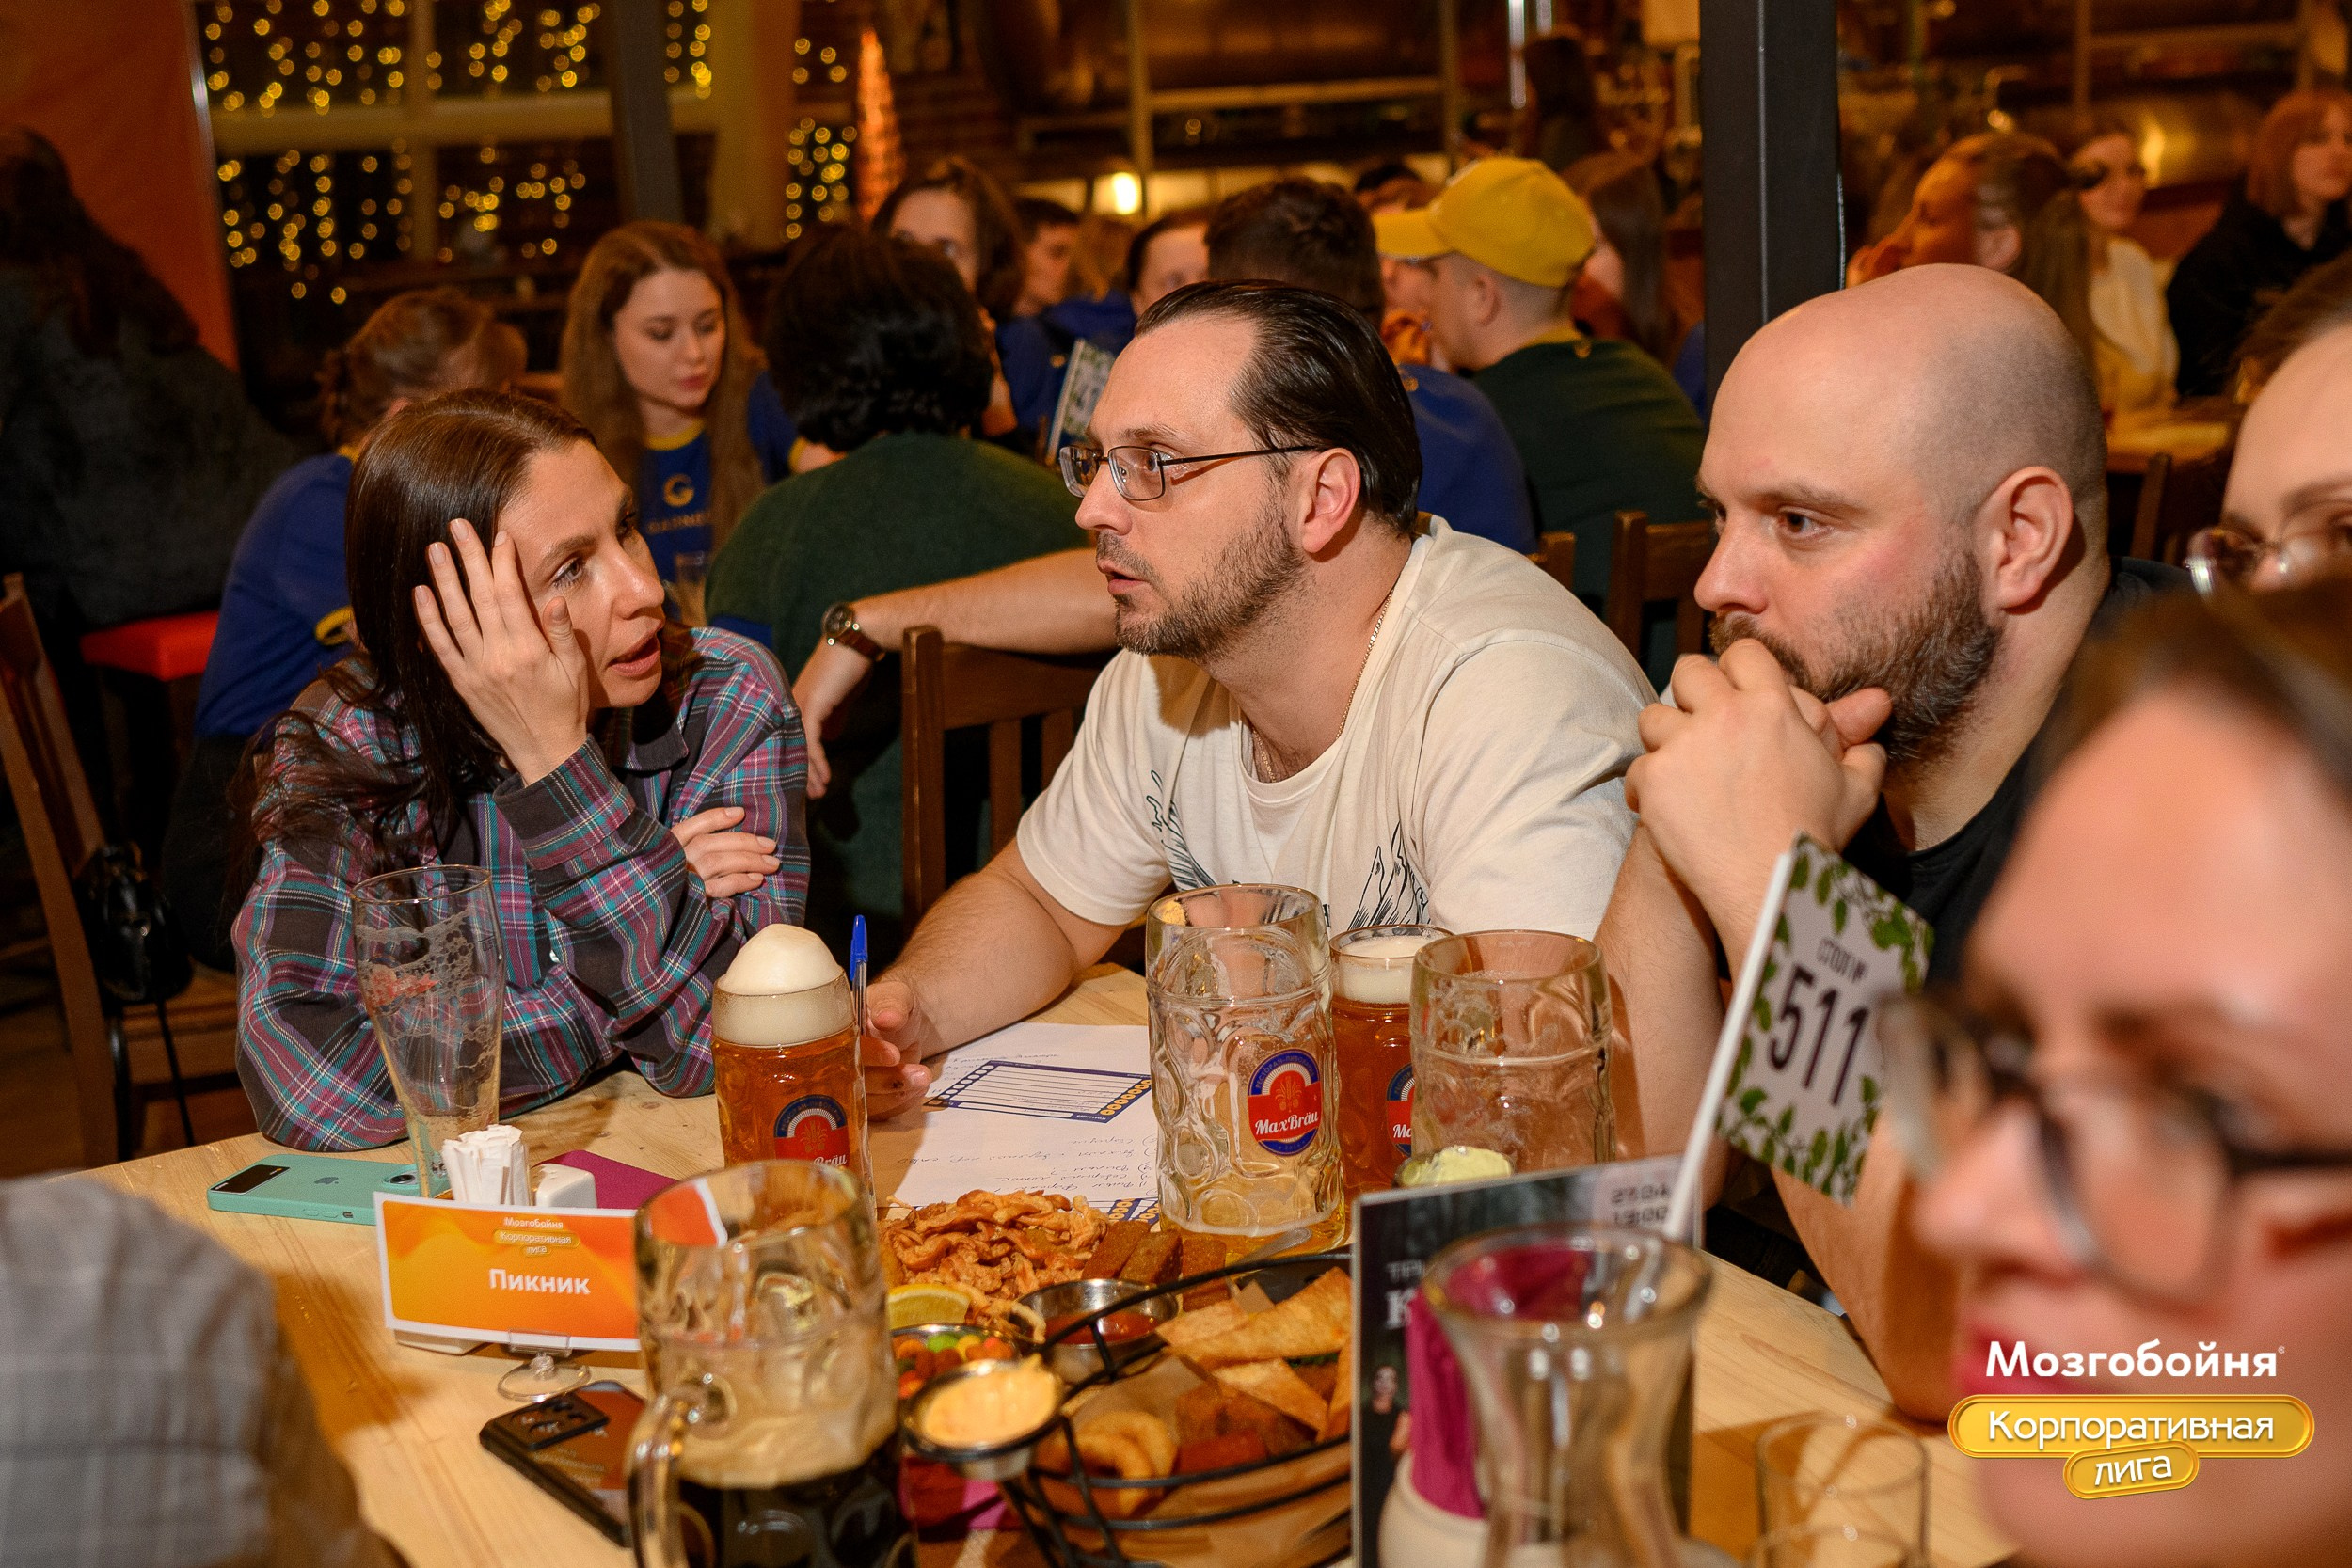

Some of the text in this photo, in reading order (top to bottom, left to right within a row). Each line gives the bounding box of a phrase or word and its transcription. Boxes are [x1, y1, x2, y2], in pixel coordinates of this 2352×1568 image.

[1768, 964, 1869, 1106] 511
[1254, 1110, 1319, 1136] MaxBräu
[503, 1216, 564, 1230] Мозгобойня
[500, 1231, 572, 1244] Корпоративная
[488, 1267, 591, 1295] Пикник
